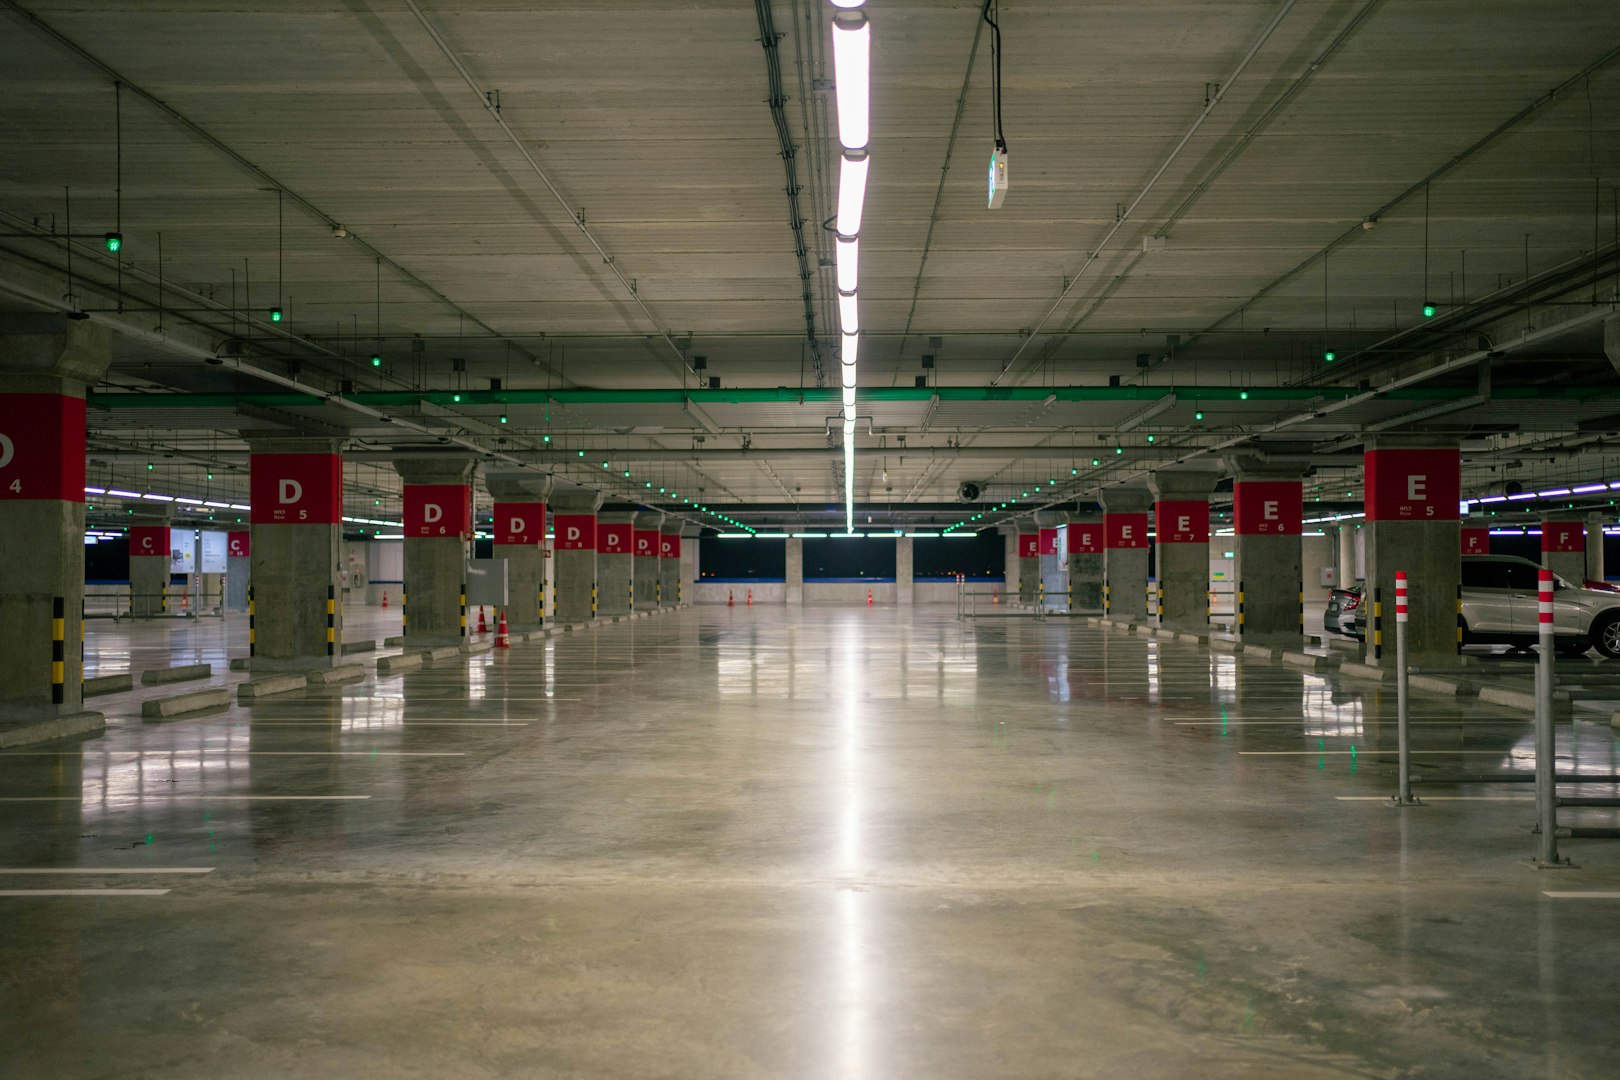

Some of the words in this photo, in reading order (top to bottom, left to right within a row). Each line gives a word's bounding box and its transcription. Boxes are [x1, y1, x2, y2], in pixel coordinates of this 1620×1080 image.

[9, 479, 22, 493] 4
[279, 479, 302, 504] D
[1408, 475, 1426, 500] E
[299, 510, 307, 520] 5
[425, 504, 442, 523] D
[1264, 501, 1278, 519] E
[1426, 506, 1434, 516] 5
[510, 517, 525, 533] D
[1178, 516, 1190, 531] E
[1278, 523, 1284, 532] 6
[440, 526, 446, 534] 6
[567, 527, 580, 540] D
[1122, 525, 1132, 539] E
[142, 537, 152, 548] C
[608, 534, 619, 545] D
[1082, 533, 1091, 545] E
[1469, 537, 1477, 547] F
[1560, 532, 1568, 544] F
[231, 540, 240, 550] C
[639, 539, 648, 549] D
[662, 543, 671, 552] D
[1029, 542, 1037, 551] E
